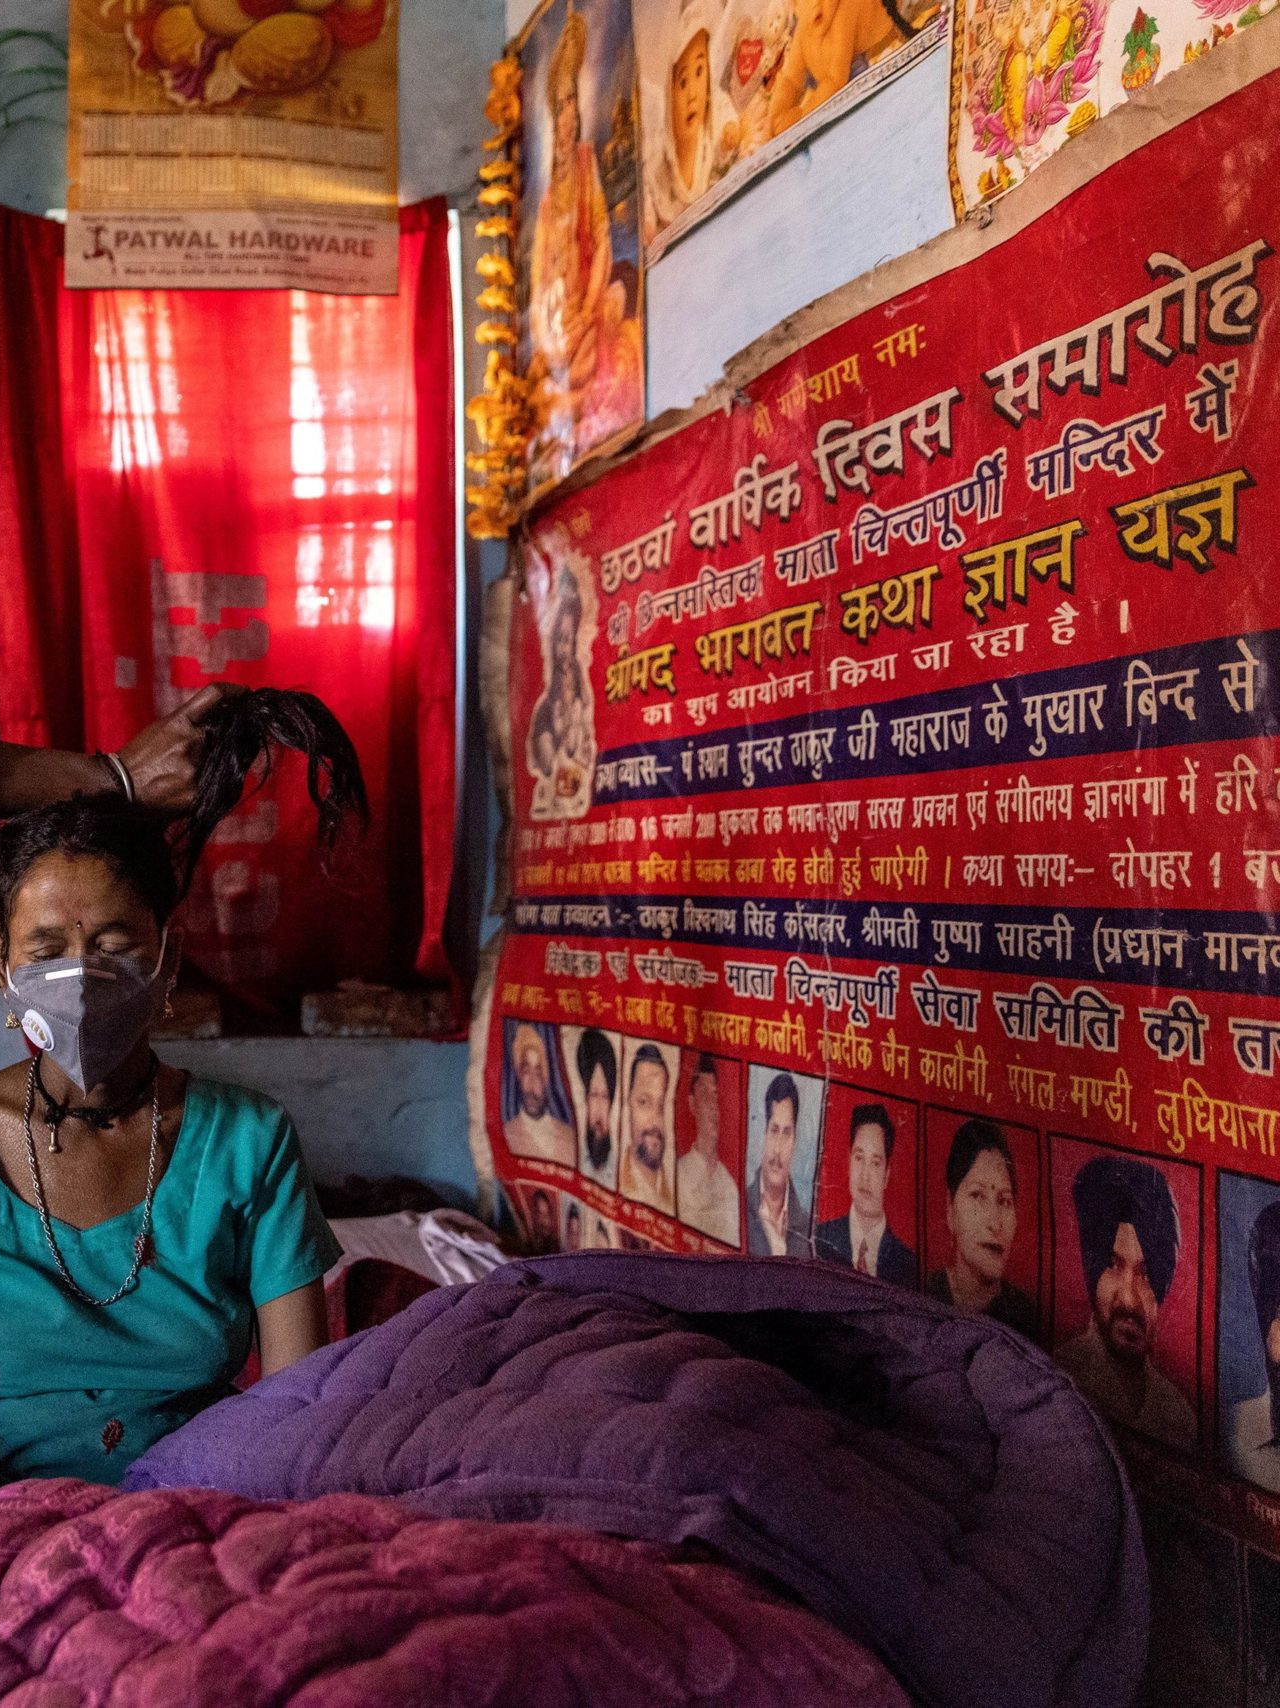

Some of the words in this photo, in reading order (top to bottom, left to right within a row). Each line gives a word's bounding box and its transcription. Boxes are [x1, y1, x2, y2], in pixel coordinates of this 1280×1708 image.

[114, 229, 219, 249] PATWAL
[229, 229, 375, 258] HARDWARE
[872, 323, 927, 367] नमः
[600, 511, 676, 594] छठवां
[689, 453, 802, 550] वार्षिक
[812, 386, 964, 504] दिवस
[982, 238, 1274, 428] समारोह
[773, 528, 840, 587] माता
[850, 447, 1007, 564] चिन्तपूर्णी
[1026, 404, 1167, 500] मन्दिर
[1185, 358, 1239, 443] में
[604, 643, 677, 702] श्रीमद
[695, 601, 822, 678] भागवत
[840, 563, 942, 645] कथा
[959, 519, 1088, 625] ज्ञान
[1108, 466, 1256, 573] यज्ञ
[641, 703, 673, 727] का
[726, 669, 815, 710] आयोजन
[827, 653, 899, 692] किया
[911, 639, 953, 671] जा
[966, 622, 1029, 660] रहा
[1048, 601, 1080, 646] है
[736, 736, 785, 788] सुन्दर
[787, 726, 838, 781] ठाकुर
[847, 709, 880, 761] जी
[889, 705, 972, 758] महाराज
[981, 683, 1009, 745] के
[1022, 684, 1108, 757] मुखार
[1122, 659, 1200, 728] बिन्द
[1218, 638, 1261, 714] से
[763, 805, 784, 835] तक
[868, 796, 905, 830] सरस
[912, 793, 959, 829] प्रवचन
[965, 780, 989, 832] एवं
[995, 774, 1074, 825] संगीतमय
[1083, 766, 1168, 823] ज्ञानगंगा
[1177, 757, 1200, 815] में
[1215, 753, 1259, 815] हरि
[637, 851, 677, 884] मन्दिर
[803, 846, 834, 886] होती
[840, 846, 862, 896] हुई
[962, 854, 1006, 887] कथा
[1109, 837, 1194, 891] दोपहर
[1209, 851, 1221, 889] 1
[637, 904, 680, 938] ठाकुर
[742, 900, 778, 939] सिंह
[861, 906, 921, 950] श्रीमती
[931, 918, 984, 963] पुष्पा
[995, 912, 1075, 963] साहनी
[1092, 916, 1186, 974] (प्रधान
[723, 960, 778, 1001] माता
[784, 956, 900, 1028] चिन्तपूर्णी
[910, 968, 982, 1033] सेवा
[993, 982, 1125, 1053] समिति
[1138, 995, 1210, 1066] की
[755, 1008, 812, 1062] कालौनी,
[817, 1022, 873, 1071] नजदीक
[880, 1027, 911, 1080] जैन
[918, 1038, 993, 1104] कालौनी,
[1070, 1066, 1139, 1134] मण्डी,
[1154, 1076, 1280, 1157] लुधियाना
